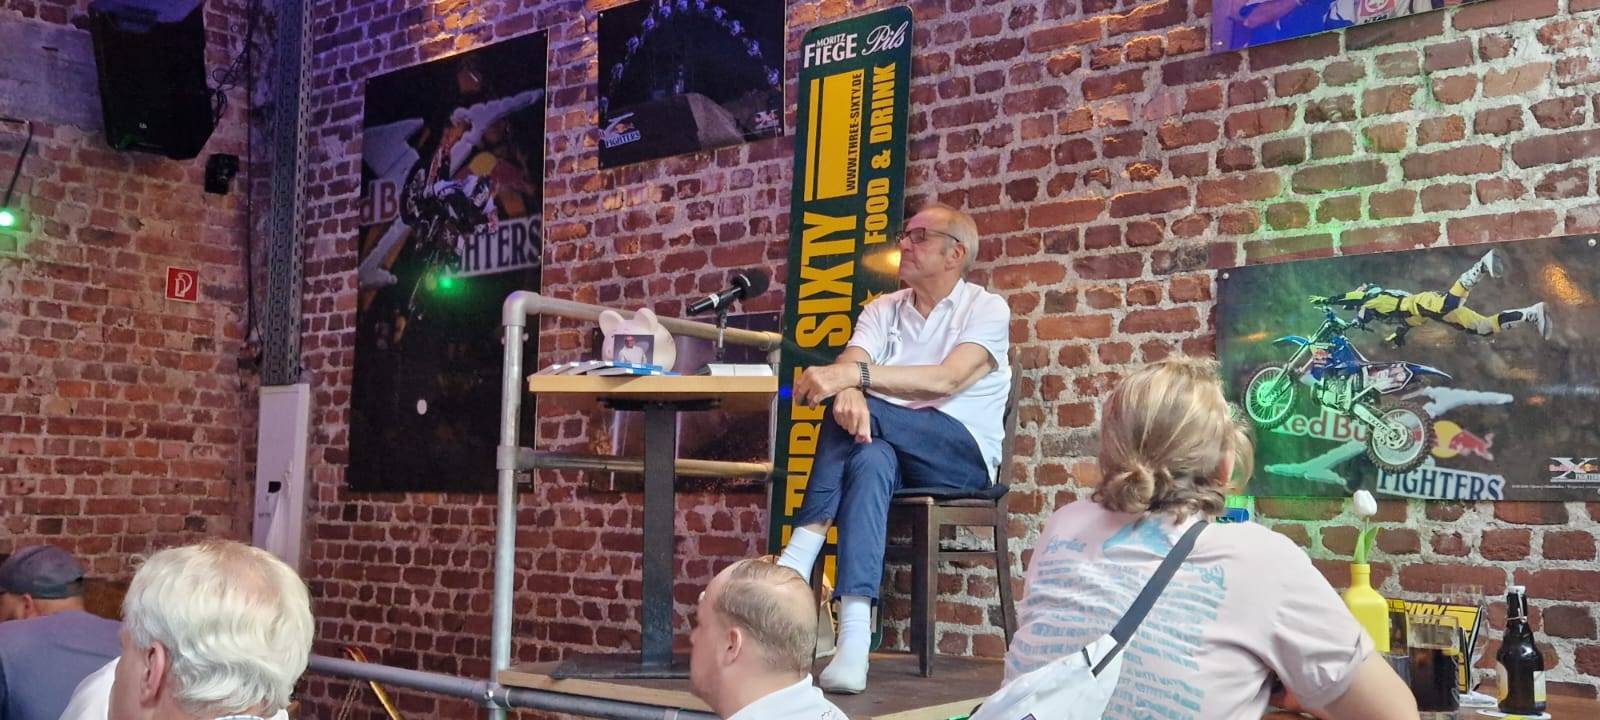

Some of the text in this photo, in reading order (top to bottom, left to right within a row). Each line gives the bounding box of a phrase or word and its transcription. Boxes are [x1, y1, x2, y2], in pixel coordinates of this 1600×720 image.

[803, 20, 909, 68] FIEGE Pils
[816, 33, 846, 47] MORITZ
[847, 72, 863, 192] WWW.THREE-SIXTY.DE
[864, 62, 896, 244] FOOD & DRINK
[796, 212, 857, 348] SIXTY
